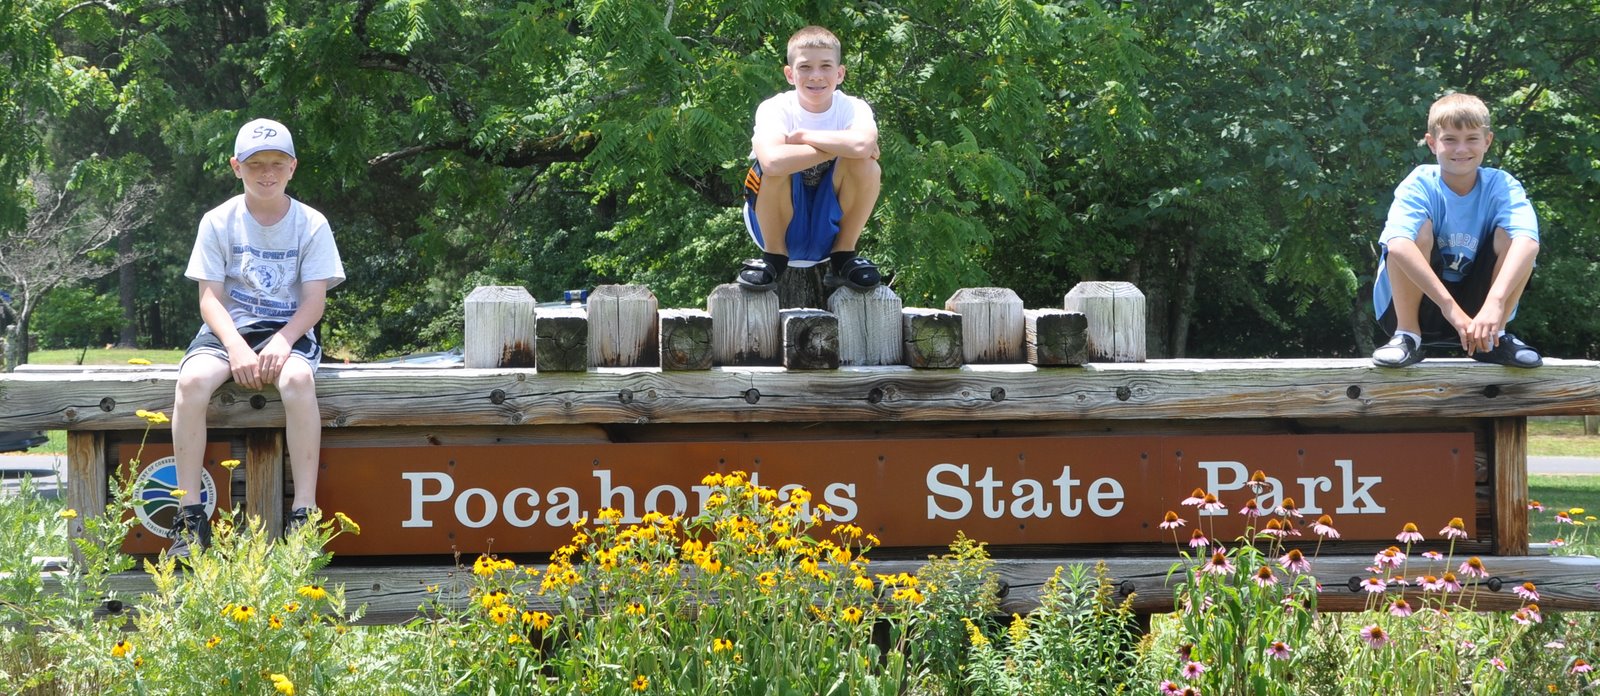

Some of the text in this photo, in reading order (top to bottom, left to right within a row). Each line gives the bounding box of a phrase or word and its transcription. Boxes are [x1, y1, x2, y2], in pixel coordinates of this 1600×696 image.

[252, 126, 277, 139] SP
[926, 463, 1124, 520] State
[1198, 459, 1386, 516] Park
